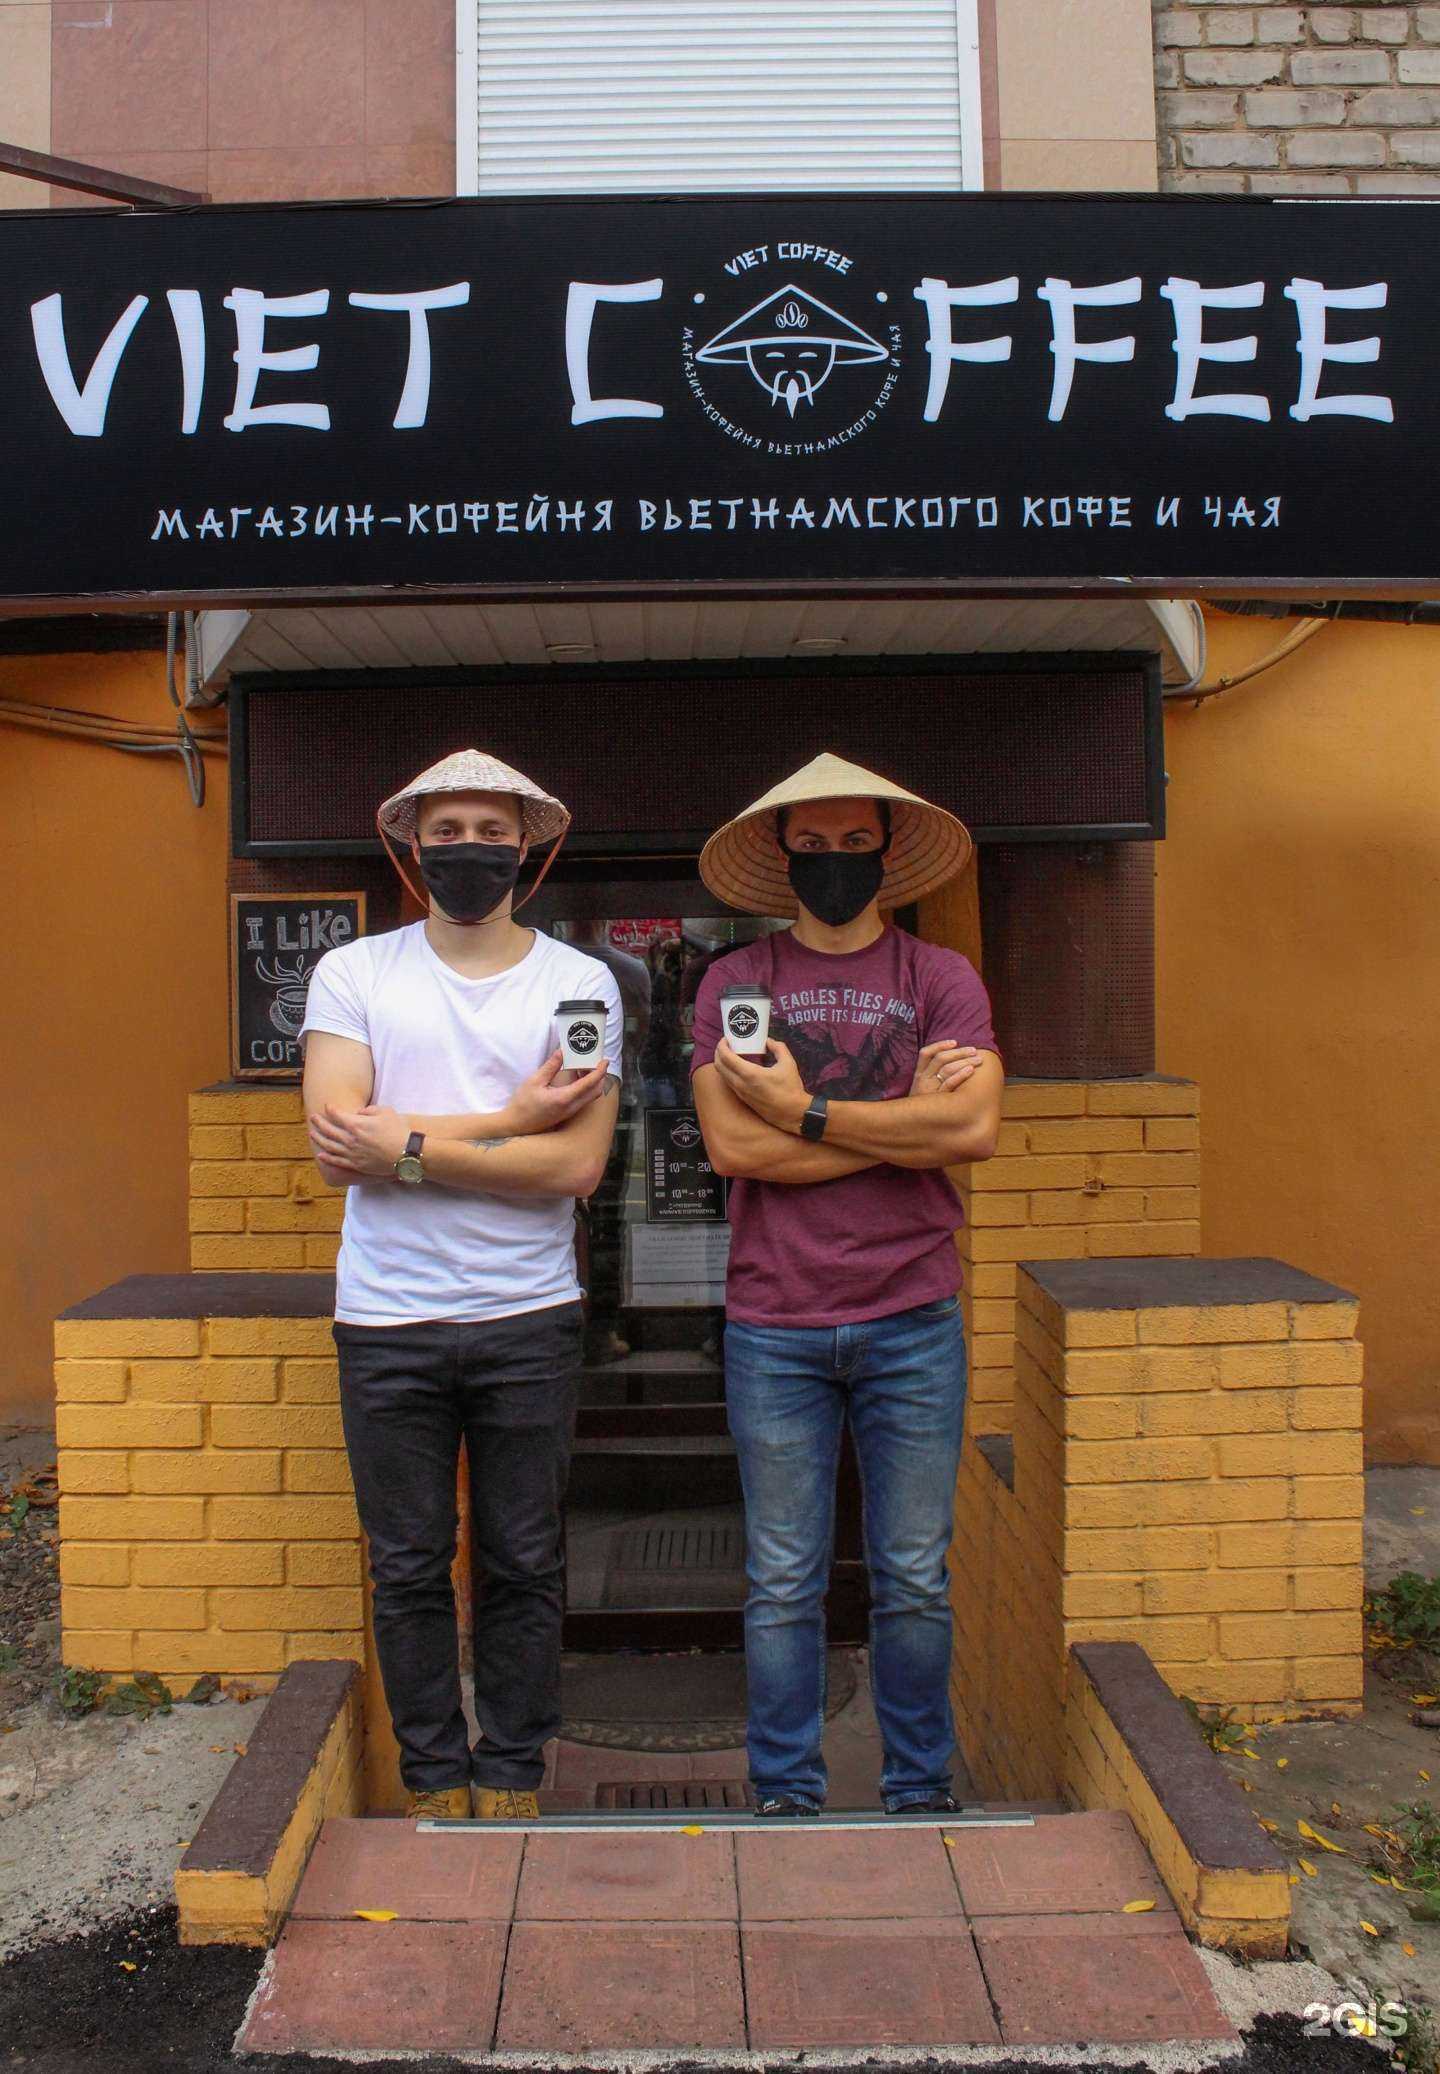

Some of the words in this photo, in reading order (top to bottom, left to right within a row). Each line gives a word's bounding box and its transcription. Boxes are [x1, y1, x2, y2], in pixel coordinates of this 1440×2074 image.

[725, 246, 768, 276] VIET
[778, 243, 853, 275] COFFEE
[888, 324, 902, 351] ЧАЯ
[31, 282, 470, 436] VIET
[890, 358, 902, 368] И
[682, 327, 762, 449] МАГАЗИН-КОФЕЙНЯ
[874, 373, 899, 409] КОФЕ
[768, 409, 877, 455] ВЬЕТНАМСКОГО
[151, 494, 612, 540] МАГАЗИН-КОФЕЙНЯ
[639, 496, 997, 531] ВЬЕТНАМСКОГО
[1024, 496, 1132, 527] КОФЕ
[1157, 497, 1180, 527] И
[1205, 496, 1281, 527] ЧАЯ
[246, 917, 264, 950] I
[779, 989, 837, 1011] EAGLES
[843, 988, 883, 1010] FLIES
[885, 998, 916, 1024] HIGH
[787, 1008, 827, 1026] ABOVE
[831, 1009, 849, 1023] ITS
[852, 1010, 885, 1026] LIMIT
[251, 1040, 300, 1062] COF
